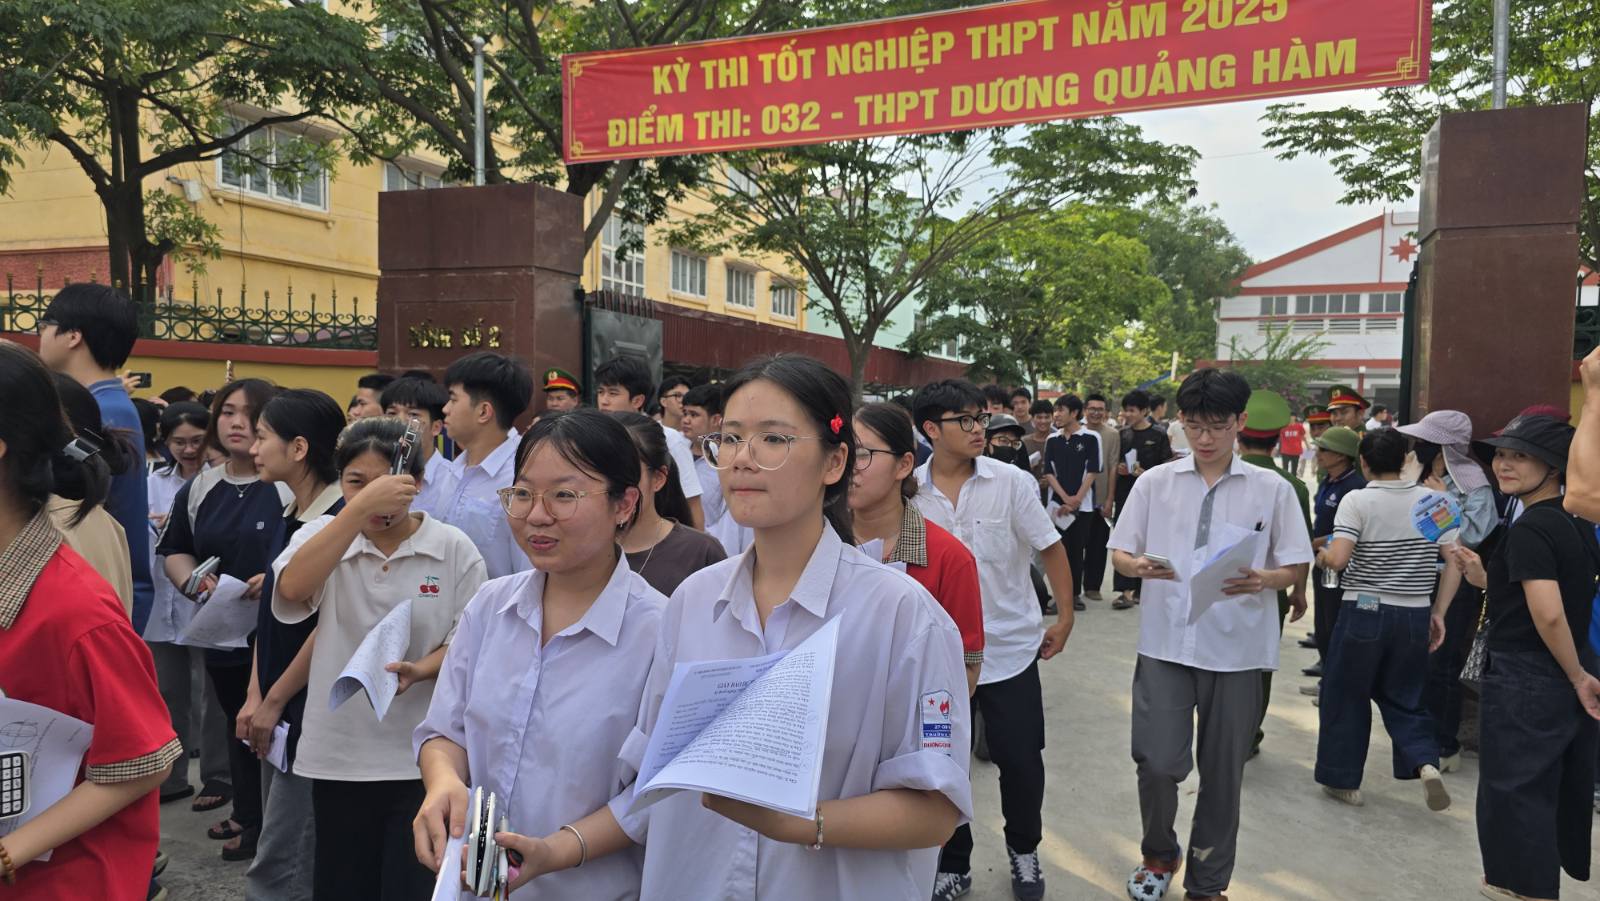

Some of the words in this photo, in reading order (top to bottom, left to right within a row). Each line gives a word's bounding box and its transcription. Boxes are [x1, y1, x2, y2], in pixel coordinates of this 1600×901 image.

[607, 104, 684, 148] ĐIỂM
[693, 108, 752, 141] THI:
[762, 101, 820, 136] 032
[831, 112, 844, 120] -
[854, 88, 939, 126] THPT
[951, 74, 1079, 118] DƯƠNG
[1094, 50, 1236, 105] QUẢNG
[1252, 37, 1357, 84] HÀM
[653, 57, 690, 95] KỲ
[700, 56, 748, 90] THI
[758, 40, 815, 84] TỐT
[827, 28, 954, 76] NGHIỆP
[966, 16, 1059, 60] THPT
[1072, 0, 1166, 48] NĂM
[1181, 0, 1289, 33] 2025
[489, 325, 500, 348] 2
